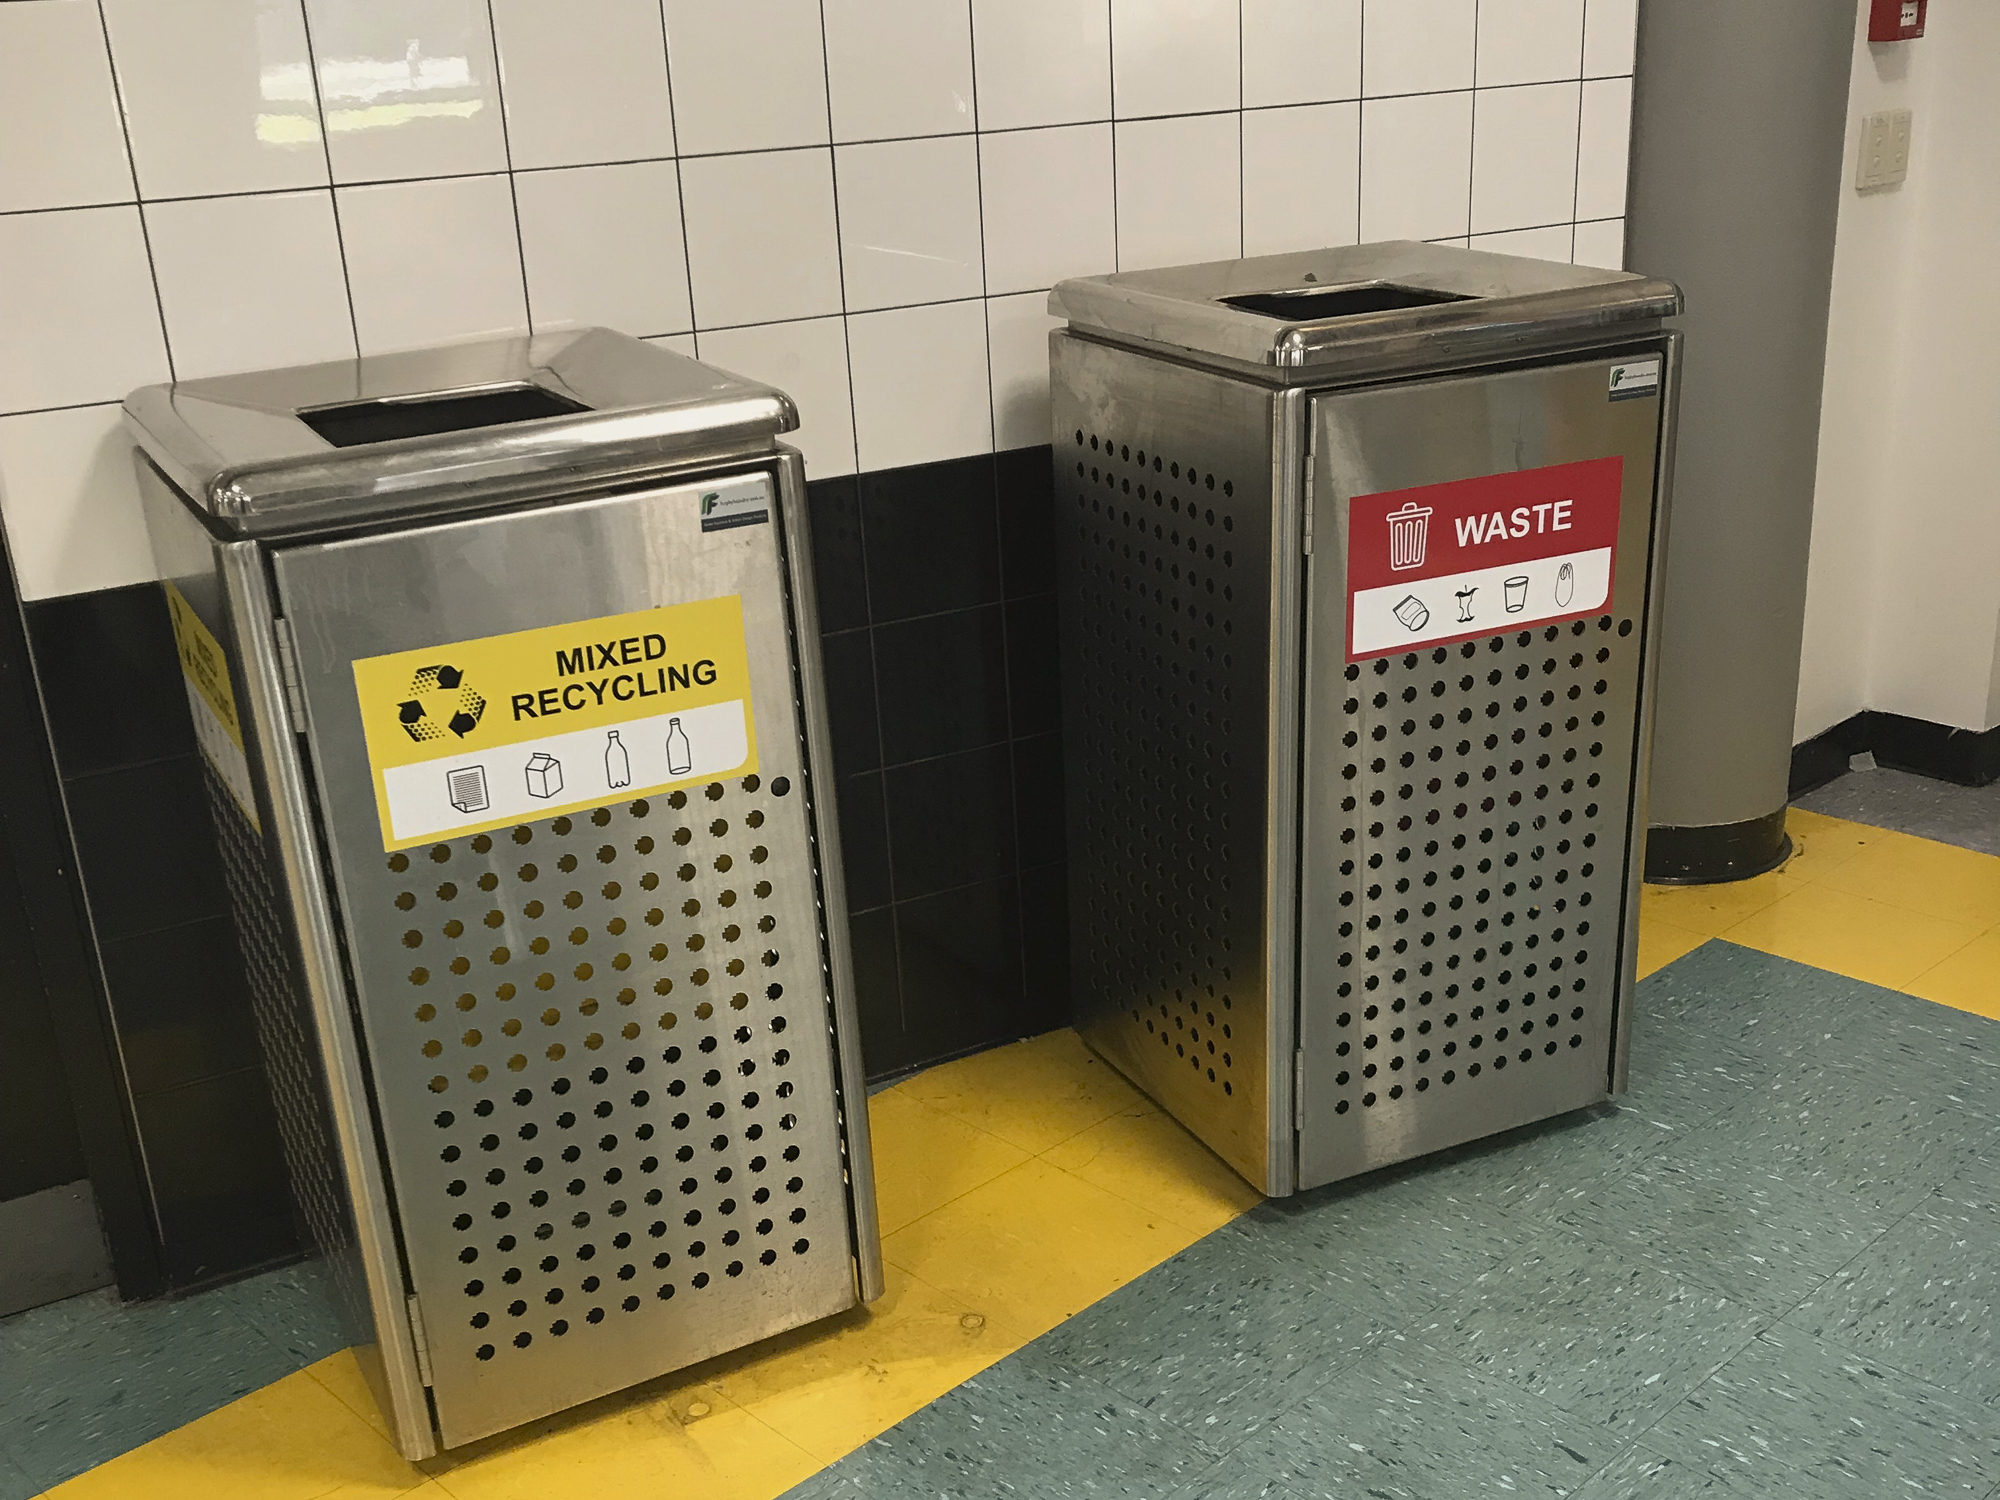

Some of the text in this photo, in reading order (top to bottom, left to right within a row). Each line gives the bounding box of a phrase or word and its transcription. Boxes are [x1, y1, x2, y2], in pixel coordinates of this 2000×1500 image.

[1454, 499, 1573, 547] WASTE
[555, 633, 667, 677] MIXED
[511, 659, 718, 722] RECYCLING
